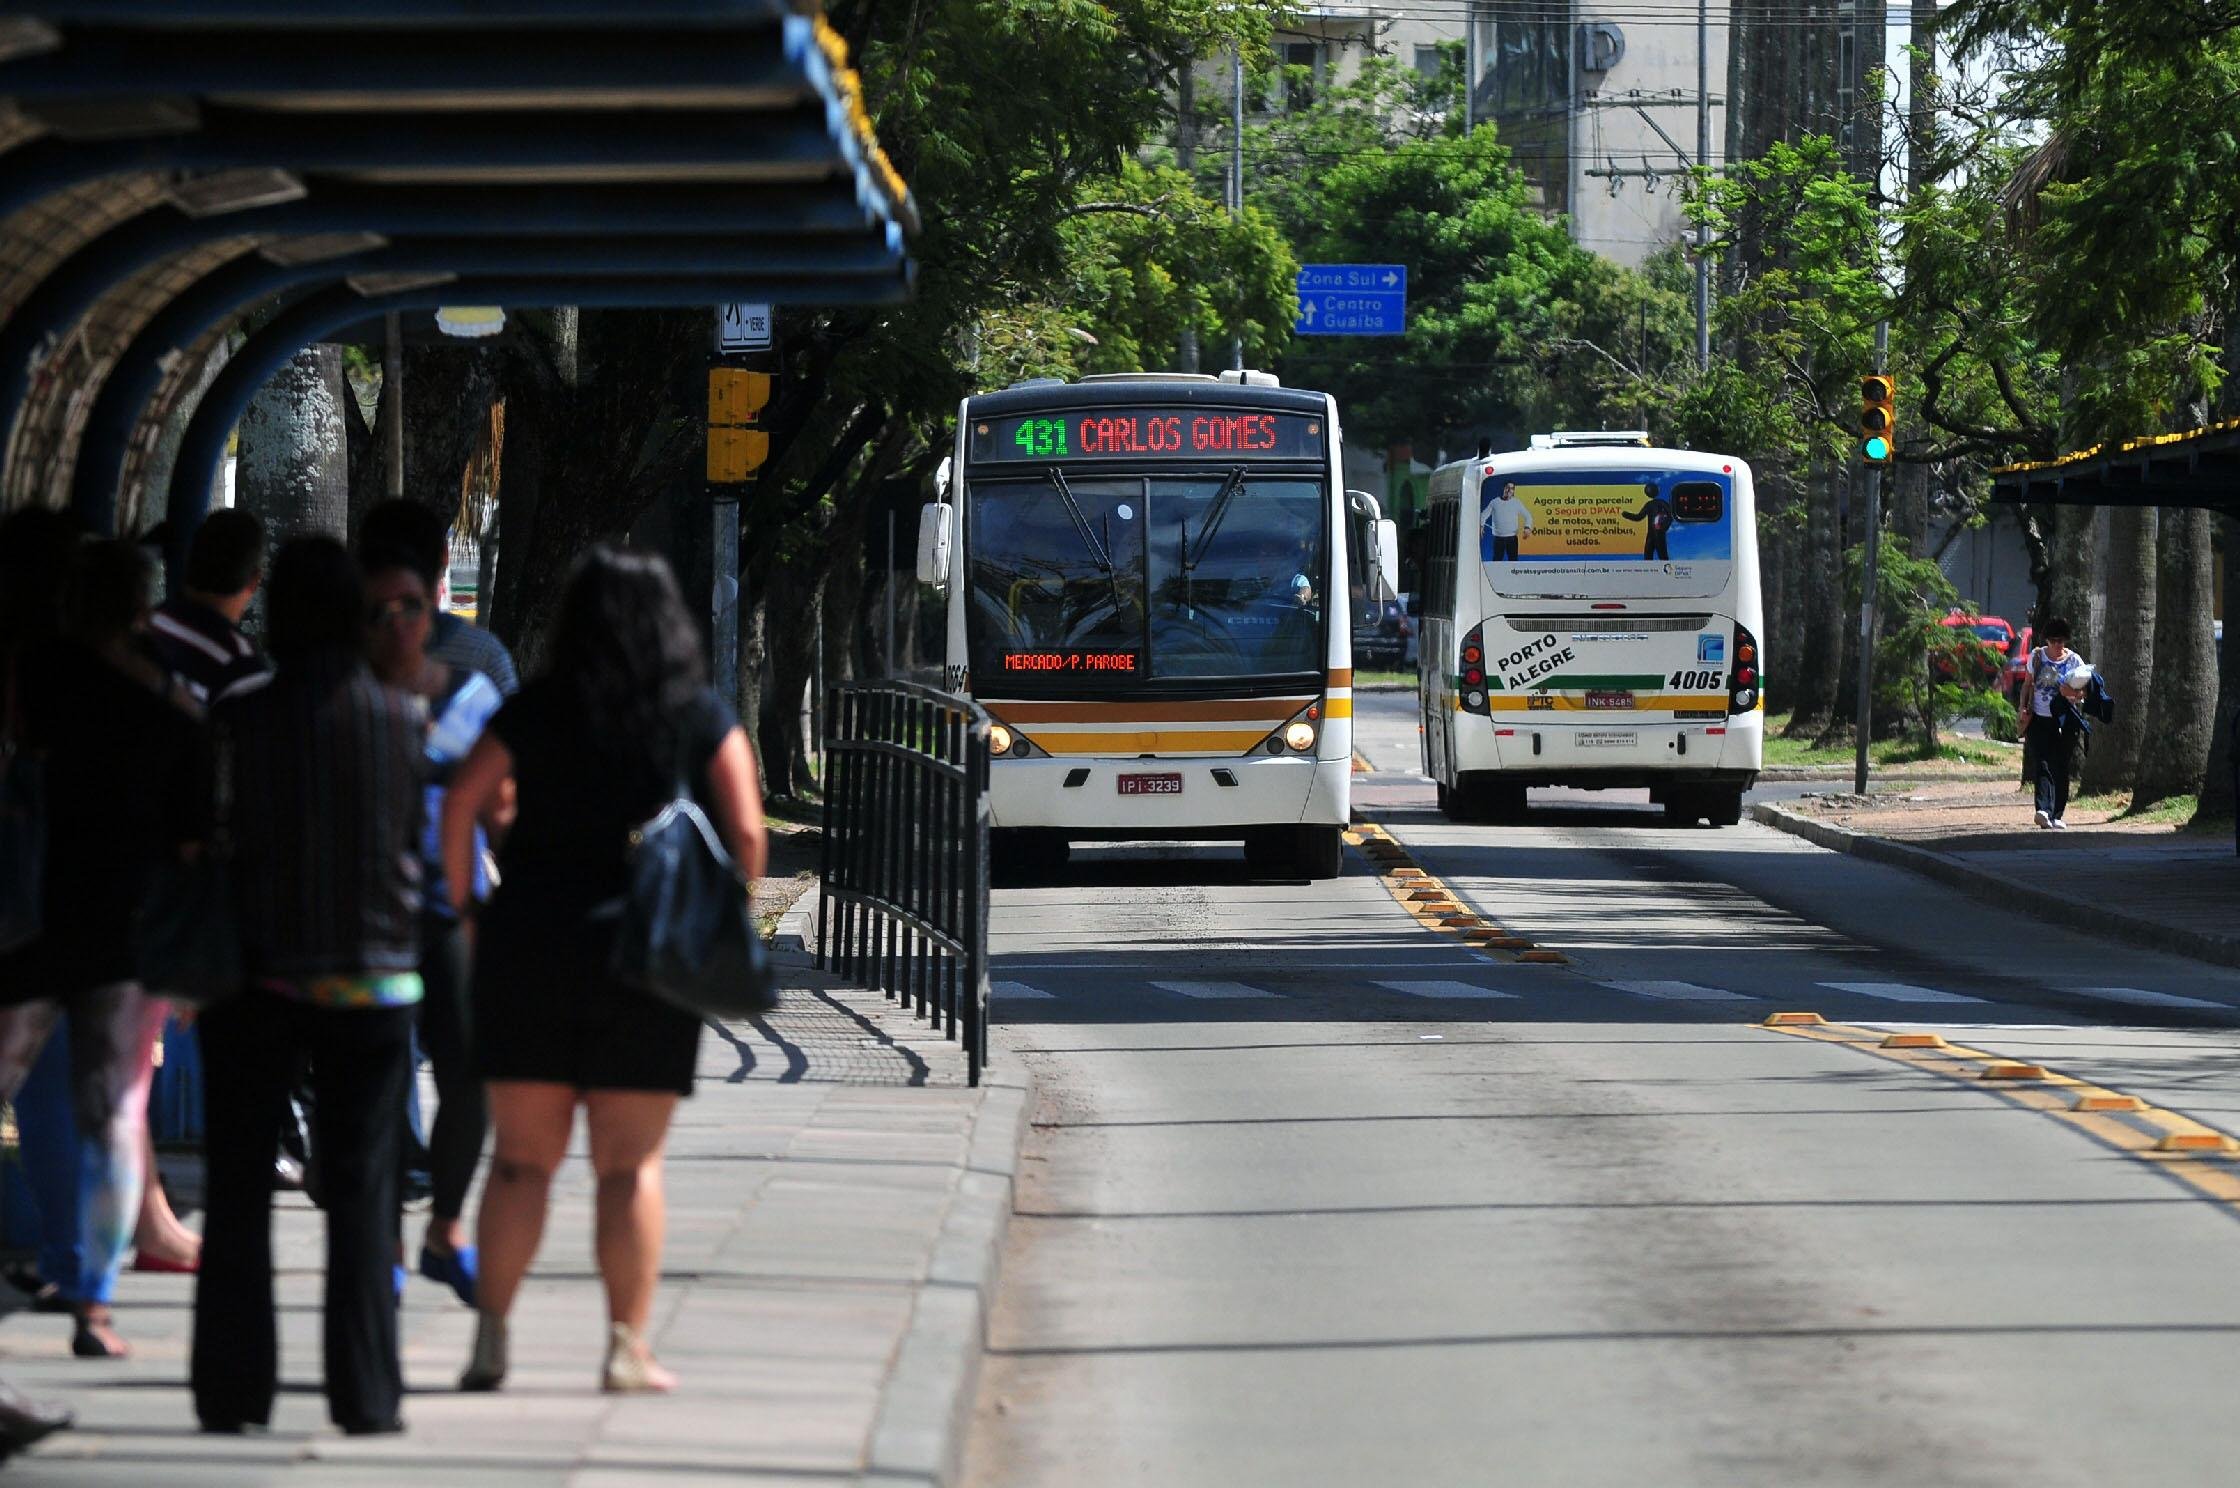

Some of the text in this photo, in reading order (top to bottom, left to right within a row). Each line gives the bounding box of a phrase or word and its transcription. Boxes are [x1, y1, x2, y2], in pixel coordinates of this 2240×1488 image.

[1300, 271, 1376, 286] Zona Sul
[1324, 296, 1382, 310] Centro
[1015, 415, 1276, 455] 431 CARLOS GOMES
[1534, 496, 1633, 507] Agora dá pra parcelar
[1555, 507, 1587, 517] Seguro
[1590, 507, 1621, 515] DPVAT
[1548, 517, 1559, 525] de
[1562, 518, 1593, 526] motos,
[1531, 527, 1561, 536] ônibus
[1498, 634, 1557, 672] PORTO
[1509, 647, 1575, 690] ALEGRE
[1669, 671, 1723, 690] 4005
